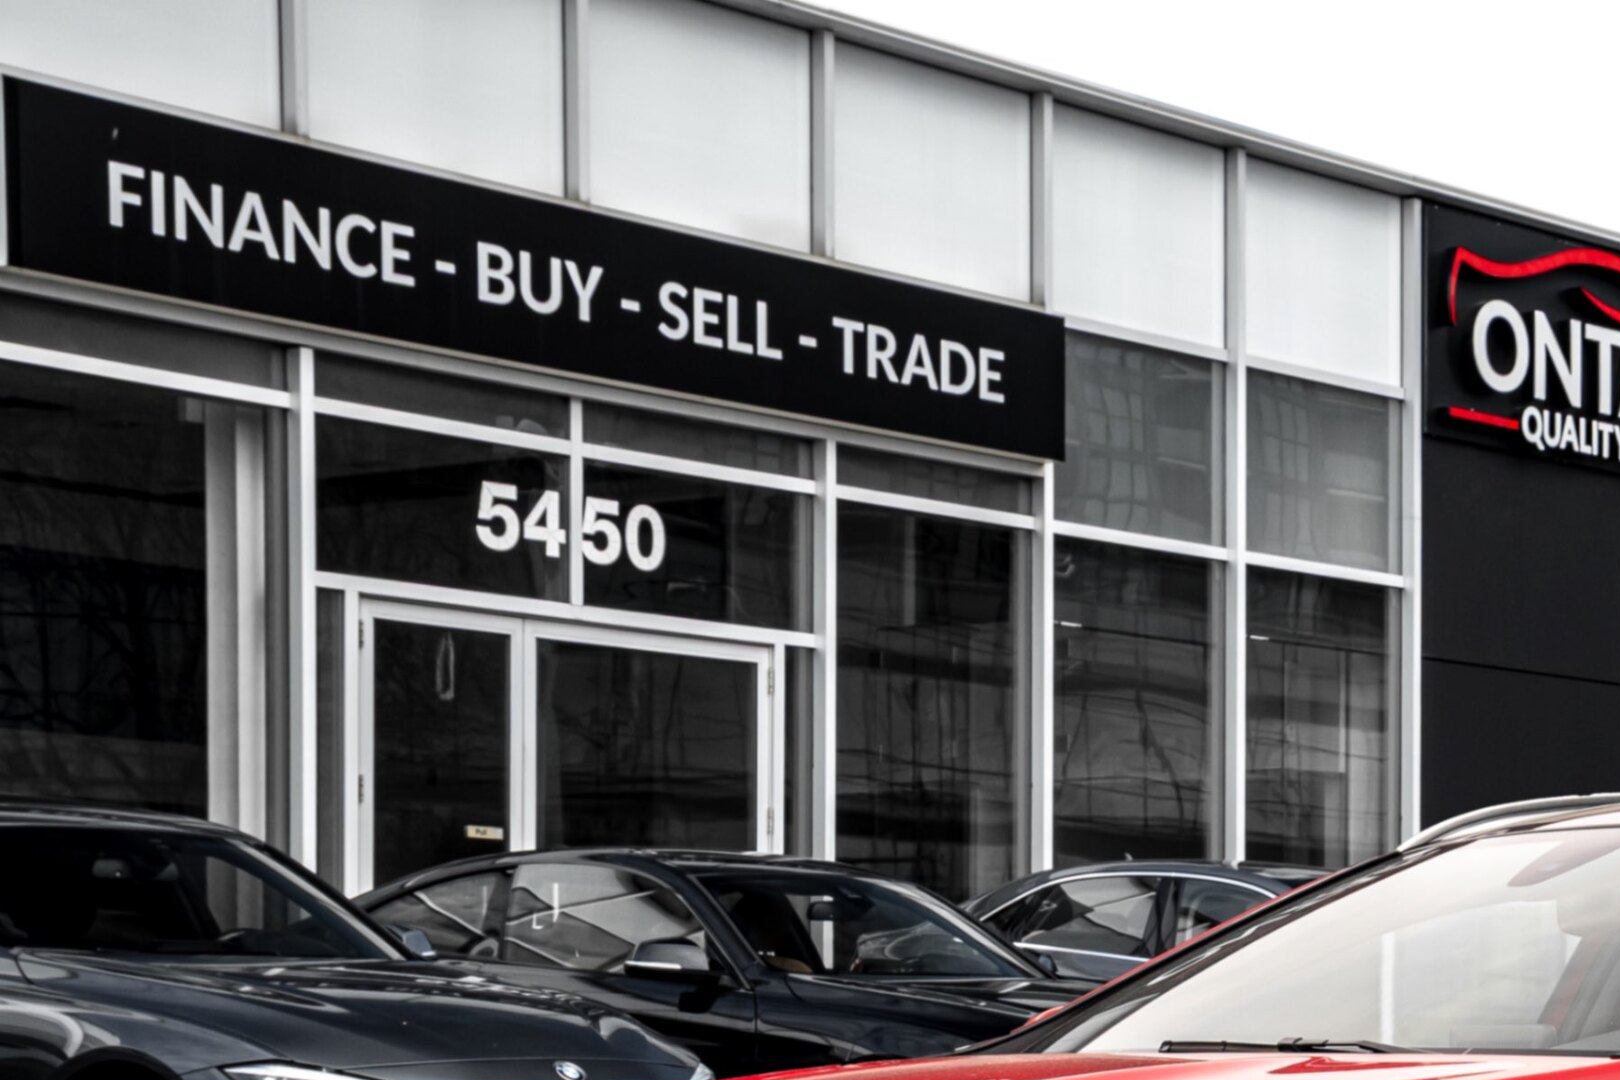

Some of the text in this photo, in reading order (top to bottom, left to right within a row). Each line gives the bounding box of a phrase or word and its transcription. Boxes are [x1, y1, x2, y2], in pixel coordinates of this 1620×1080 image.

[107, 160, 416, 287] FINANCE
[477, 242, 603, 322] BUY
[658, 281, 783, 360] SELL
[832, 316, 1005, 403] TRADE
[475, 480, 666, 572] 5450
